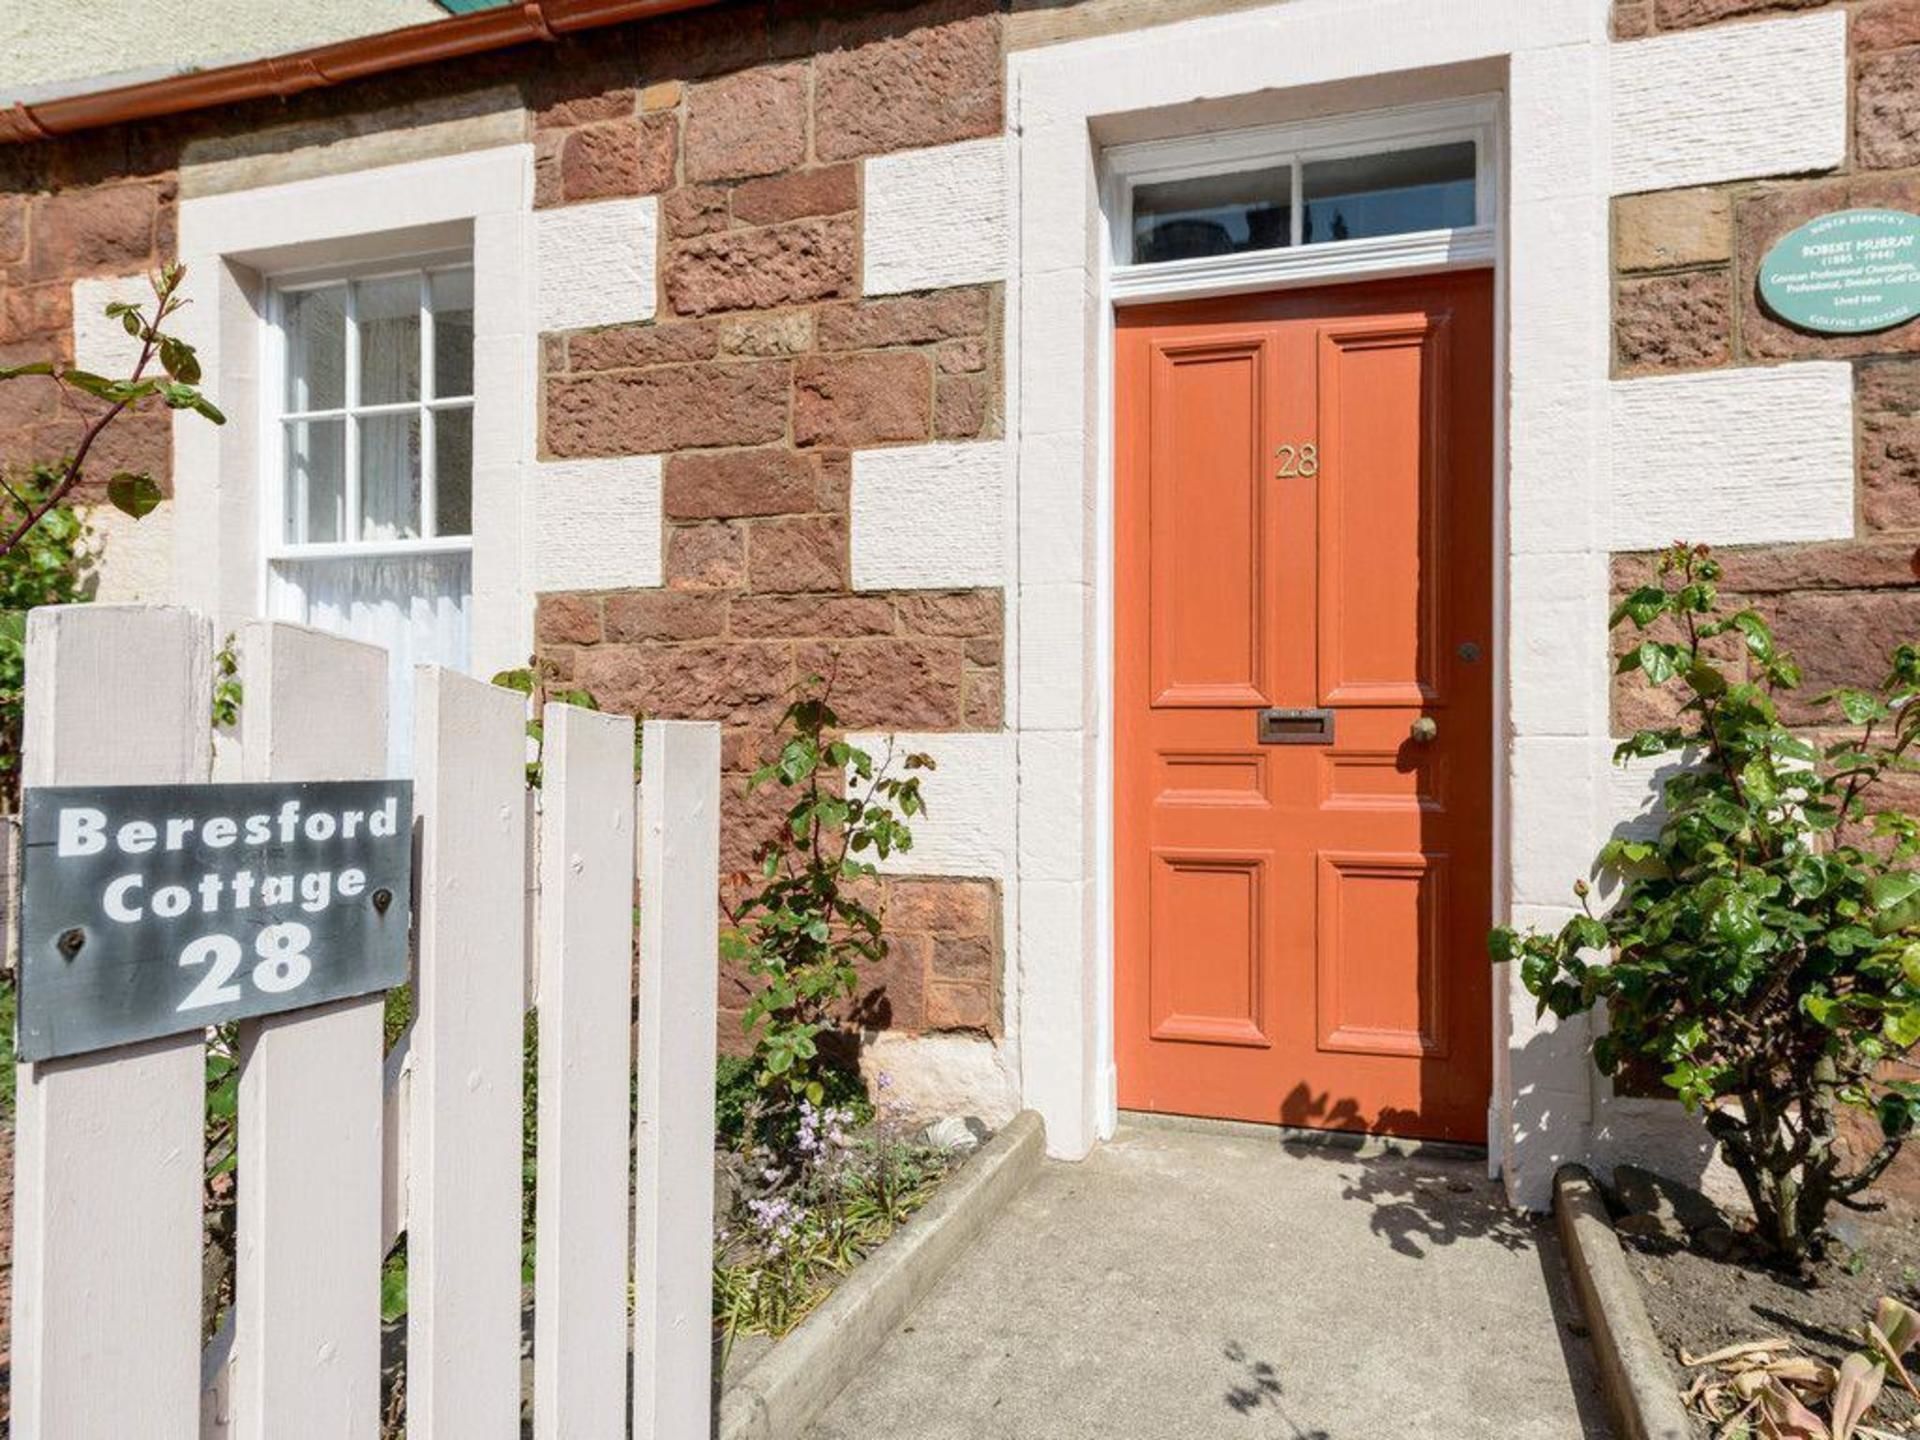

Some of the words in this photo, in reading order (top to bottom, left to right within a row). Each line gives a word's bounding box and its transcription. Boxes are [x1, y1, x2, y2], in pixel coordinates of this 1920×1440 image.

[1802, 241, 1852, 257] ROBERT
[1856, 235, 1914, 251] MURRAY
[1834, 296, 1860, 306] Lived
[1862, 294, 1882, 304] here
[1275, 443, 1317, 478] 28
[57, 797, 397, 858] Beresford
[102, 867, 366, 923] Cottage
[176, 921, 312, 1012] 28
